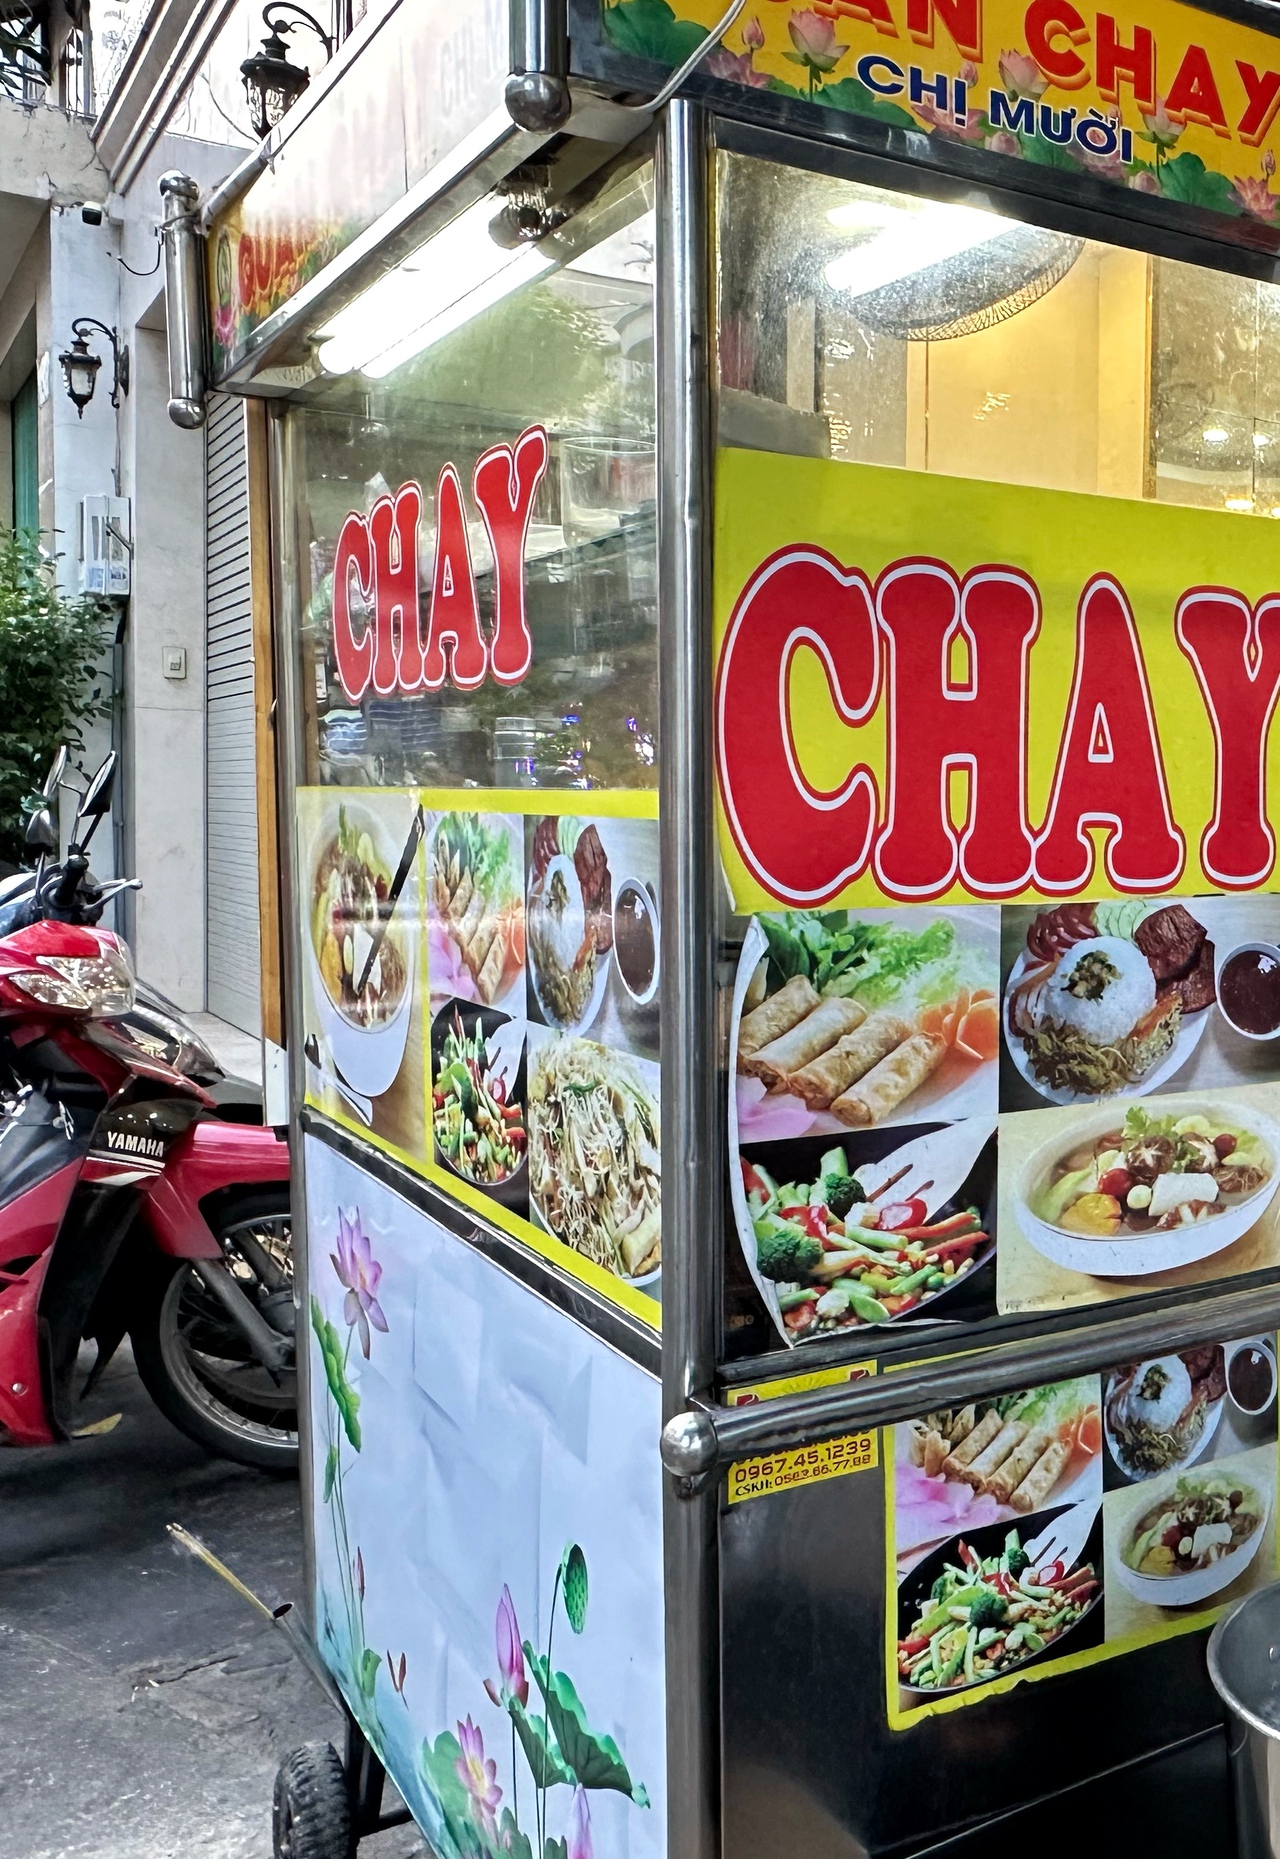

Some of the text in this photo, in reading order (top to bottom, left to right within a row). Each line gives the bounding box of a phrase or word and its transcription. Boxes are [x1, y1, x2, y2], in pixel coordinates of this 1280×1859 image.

[857, 54, 1133, 164] CHỊ MƯỜI
[332, 422, 548, 706] CHAY
[107, 1130, 164, 1157] YAMAHA
[735, 1438, 871, 1483] 0967.45.1239
